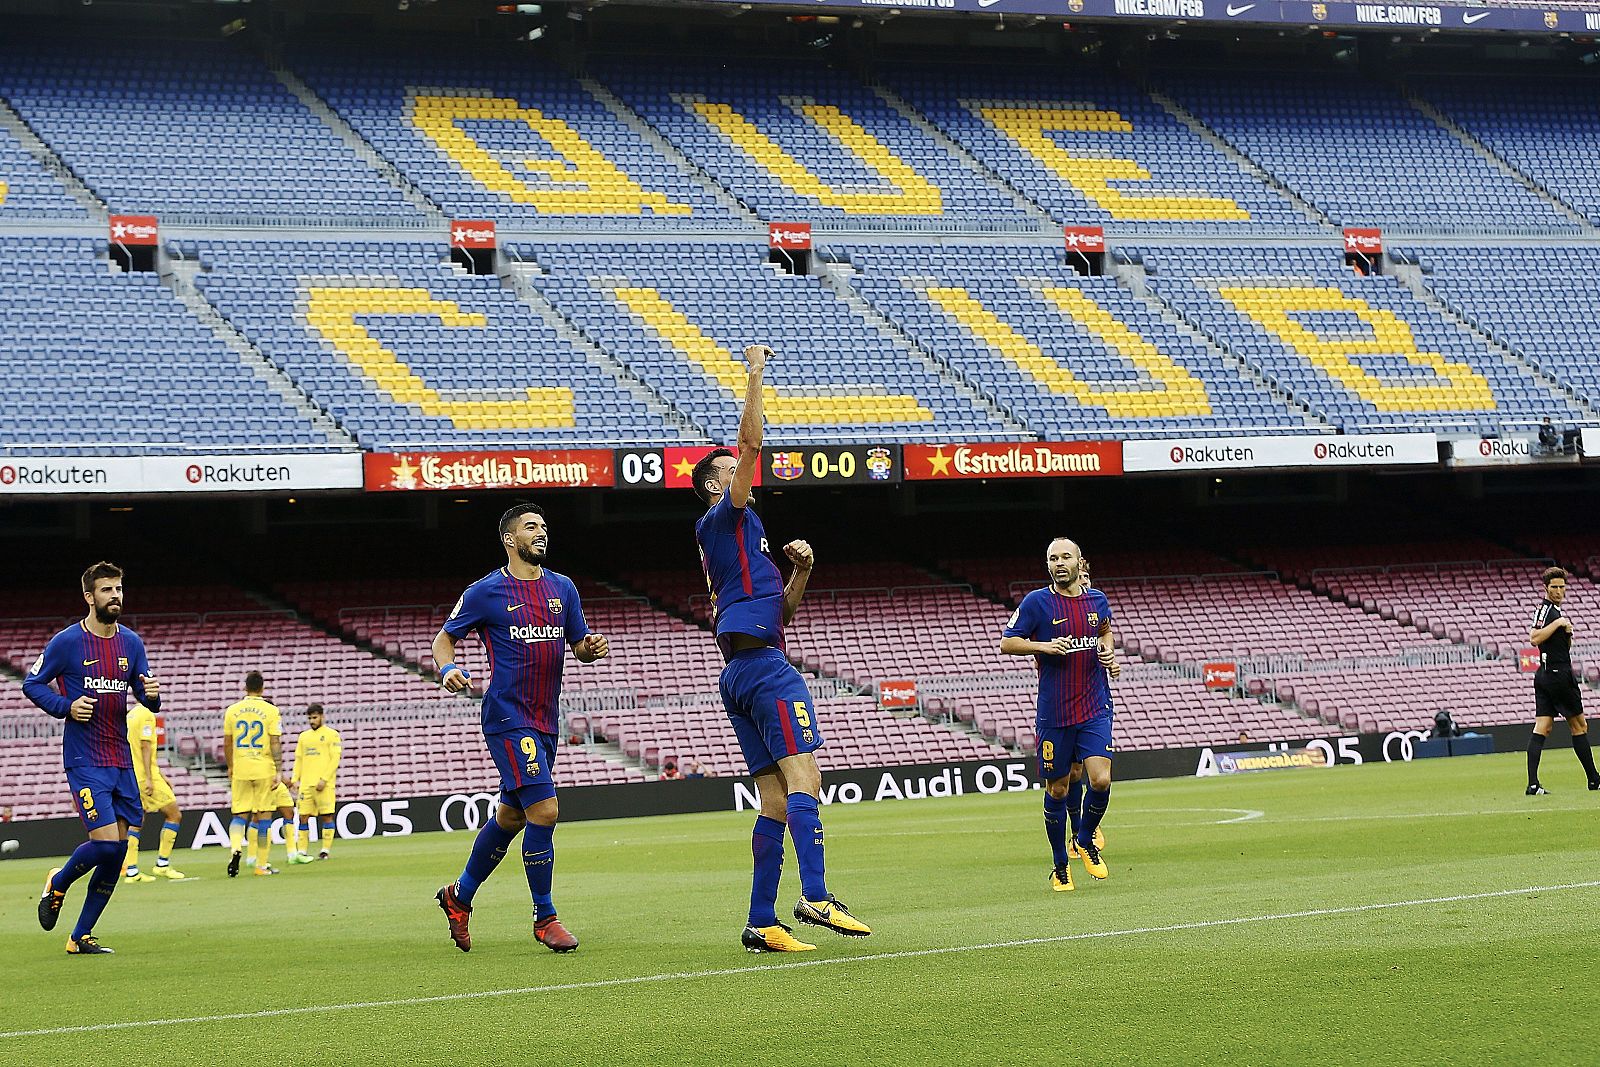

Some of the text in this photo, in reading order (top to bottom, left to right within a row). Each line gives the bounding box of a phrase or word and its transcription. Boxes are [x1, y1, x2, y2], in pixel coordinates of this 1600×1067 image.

[1113, 0, 1205, 17] NIKE.COM/FCB
[1356, 4, 1442, 25] NIKE.COM/FCB
[953, 447, 1101, 475] Estrella Damm
[1185, 445, 1254, 463] Rakuten
[1328, 442, 1395, 459] Rakuten
[18, 464, 107, 484] Rakuten
[204, 463, 290, 482] Rakuten
[421, 452, 589, 488] Estrella Damm
[622, 453, 663, 484] 03
[811, 451, 856, 479] 0-0
[509, 623, 564, 640] Rakuten
[84, 675, 128, 691] Rakuten
[792, 701, 811, 729] 5
[236, 719, 264, 748] 22
[520, 736, 537, 763] 9
[1042, 740, 1054, 761] 8
[1235, 752, 1313, 771] DEMOCRÀCIA
[874, 768, 963, 801] Audi
[79, 787, 95, 810] 3
